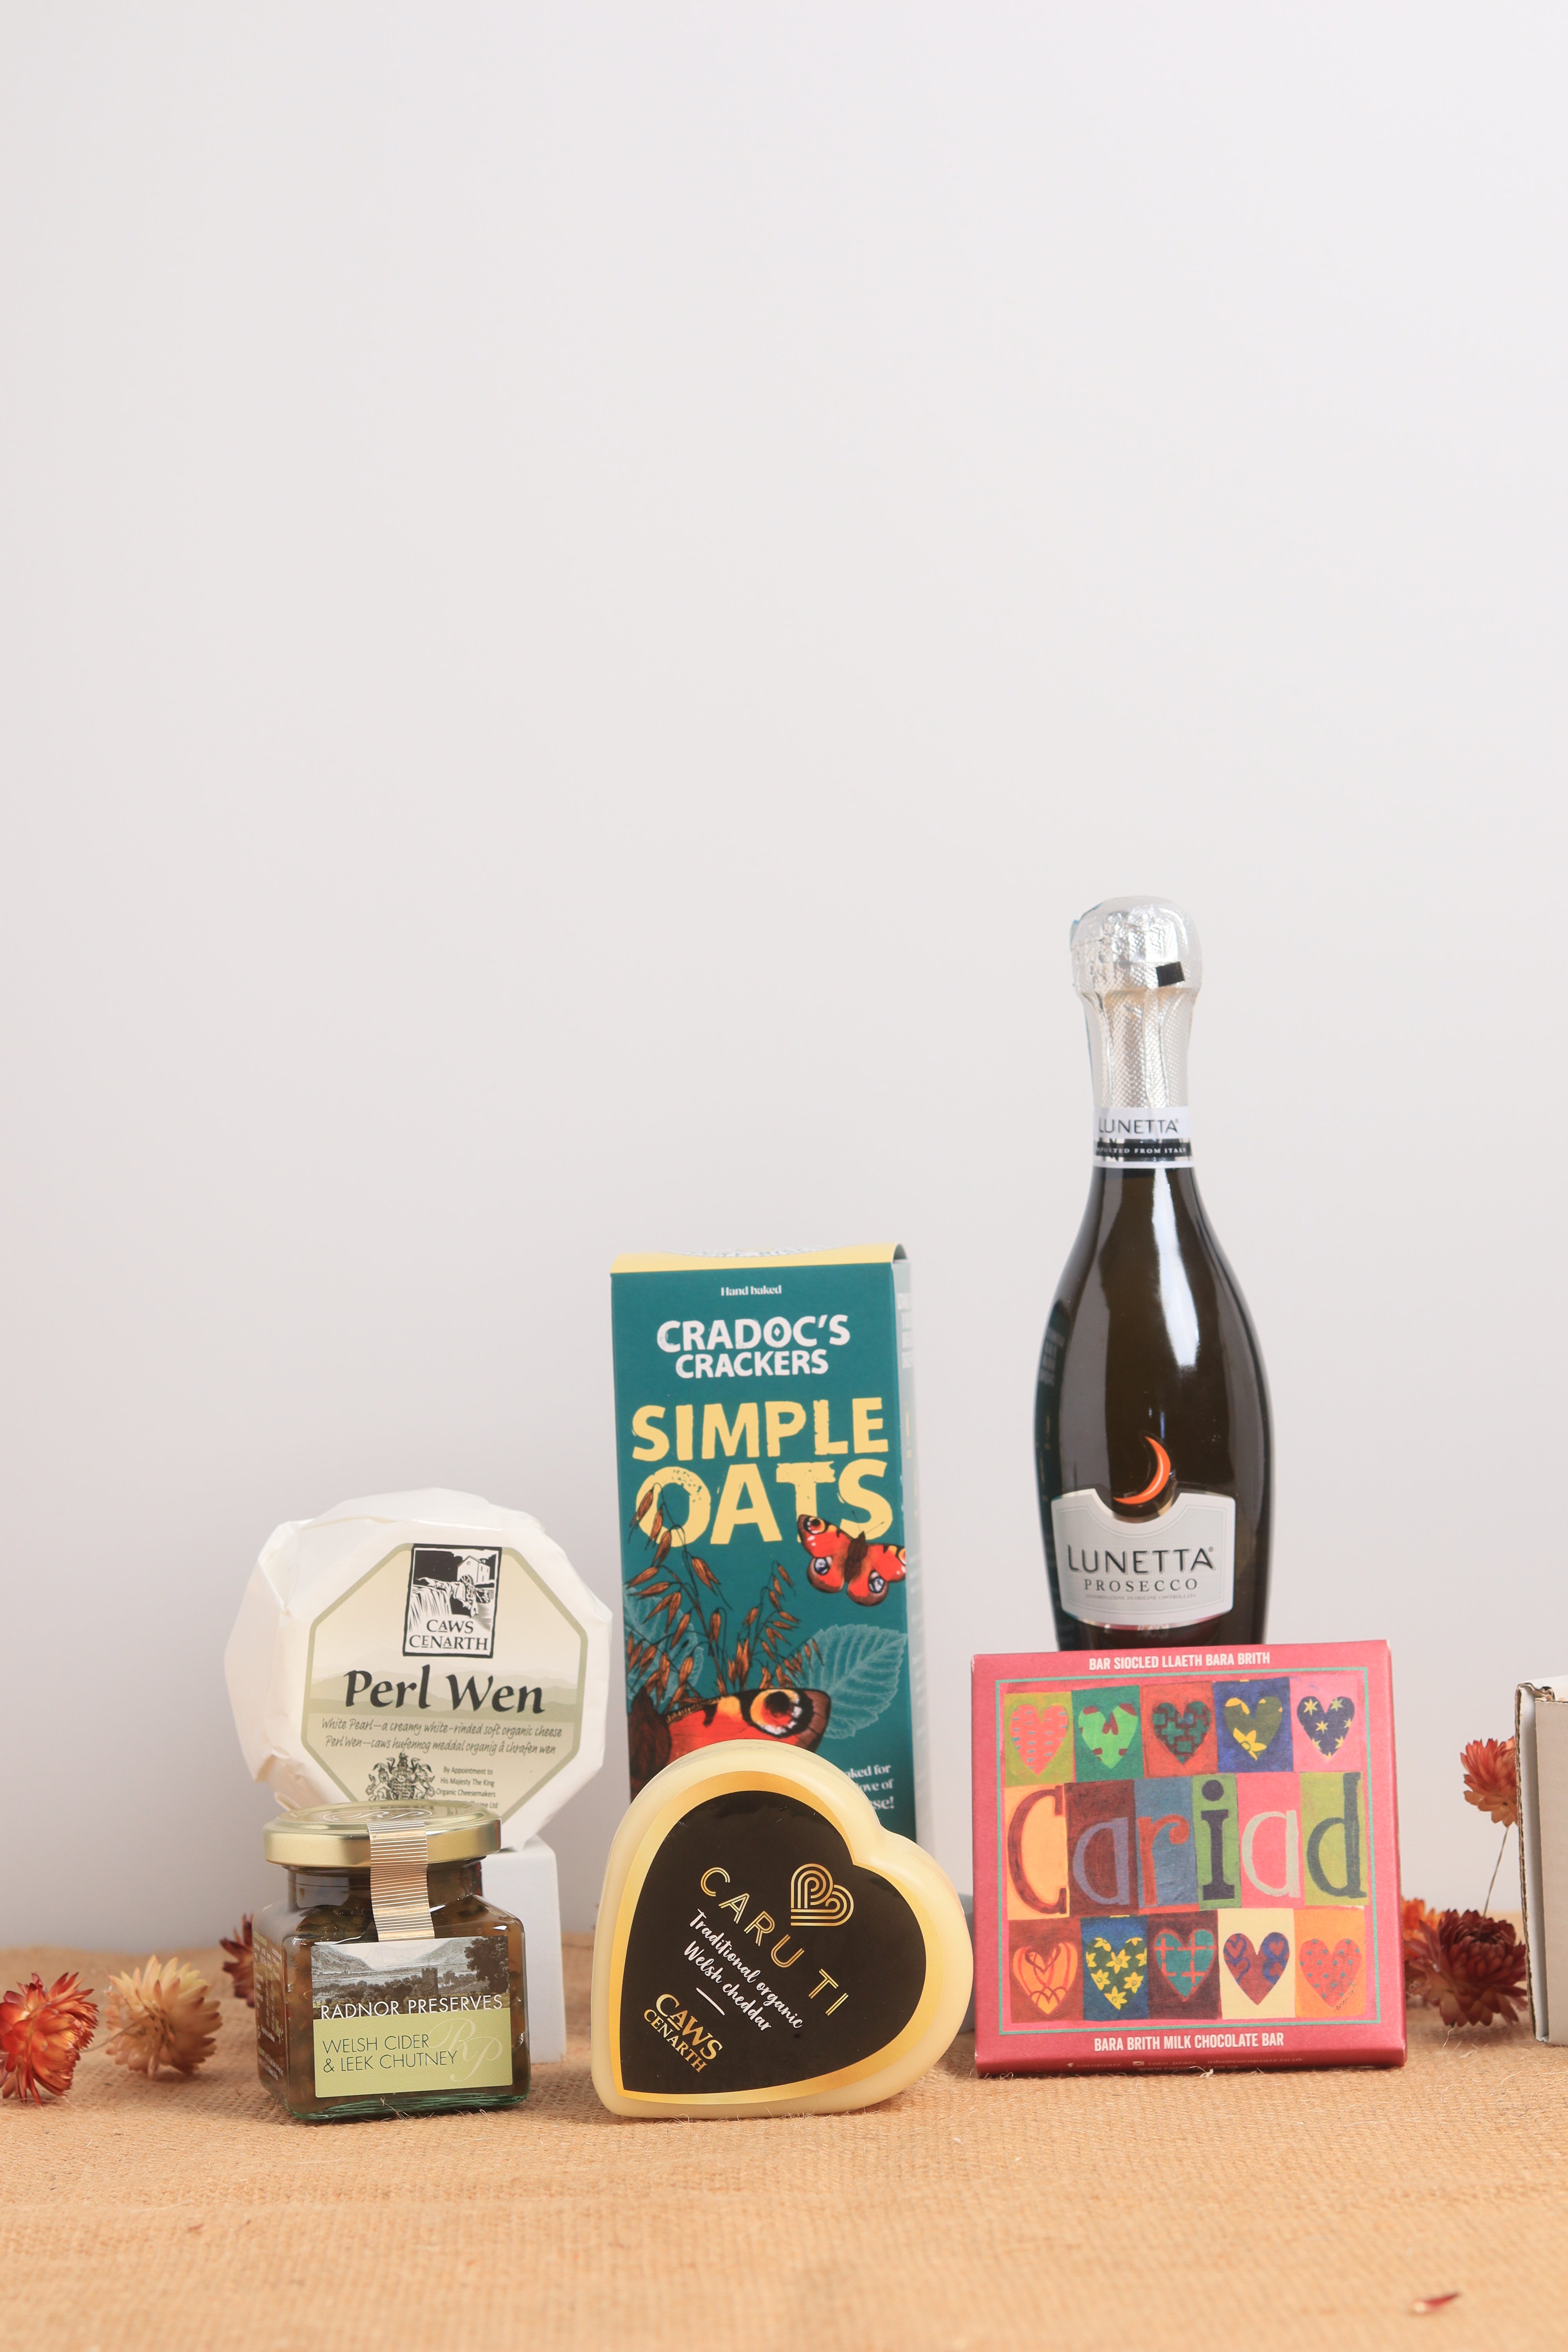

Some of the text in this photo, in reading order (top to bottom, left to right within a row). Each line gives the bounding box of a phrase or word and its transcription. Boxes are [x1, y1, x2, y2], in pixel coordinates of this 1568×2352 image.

[721, 1285, 782, 1296] Hand baked
[657, 1314, 850, 1353] CRADOC'S
[675, 1349, 828, 1378] CRACKERS
[632, 1397, 889, 1461] SIMPLE
[636, 1458, 893, 1547] OATS
[1084, 1578, 1197, 1592] PROSECCO
[426, 1619, 474, 1634] CAWS
[409, 1635, 488, 1651] CENARTH
[1089, 1651, 1270, 1670] BAR SIOCLED LLAETH BARA BRITH
[343, 1664, 545, 1714] Perl Wen
[321, 1718, 347, 1730] White
[390, 1723, 422, 1736] creamy
[483, 1724, 501, 1738] soft
[502, 1727, 533, 1742] organic
[534, 1726, 562, 1738] cheese
[325, 1735, 344, 1747] Perl
[392, 1737, 431, 1753] hufennog
[432, 1739, 465, 1751] meddal
[465, 1742, 497, 1756] organig
[506, 1742, 539, 1755] chrafen
[539, 1745, 556, 1755] wen
[443, 1766, 450, 1774] By
[451, 1767, 486, 1775] Appointment
[844, 1764, 891, 1779] aked for
[436, 1788, 496, 1798] Organic Cheesemakers
[450, 1777, 471, 1786] Majesty
[483, 1779, 495, 1788] King
[881, 1778, 894, 1790] of
[1007, 1771, 1367, 1915] Cariad
[690, 1908, 803, 2029] Traditional organic
[684, 1940, 772, 2031] Welsh cheddar
[320, 1994, 503, 2020] RADNOR PRESERVES
[655, 1993, 723, 2060] CAWS
[322, 2034, 430, 2054] WELSH CIDER
[643, 2009, 708, 2073] CENARTH
[1094, 2032, 1284, 2051] BARA BRITH MILK CHOCOLATE BAR
[323, 2050, 457, 2073] & LEEK CHUTNEY
